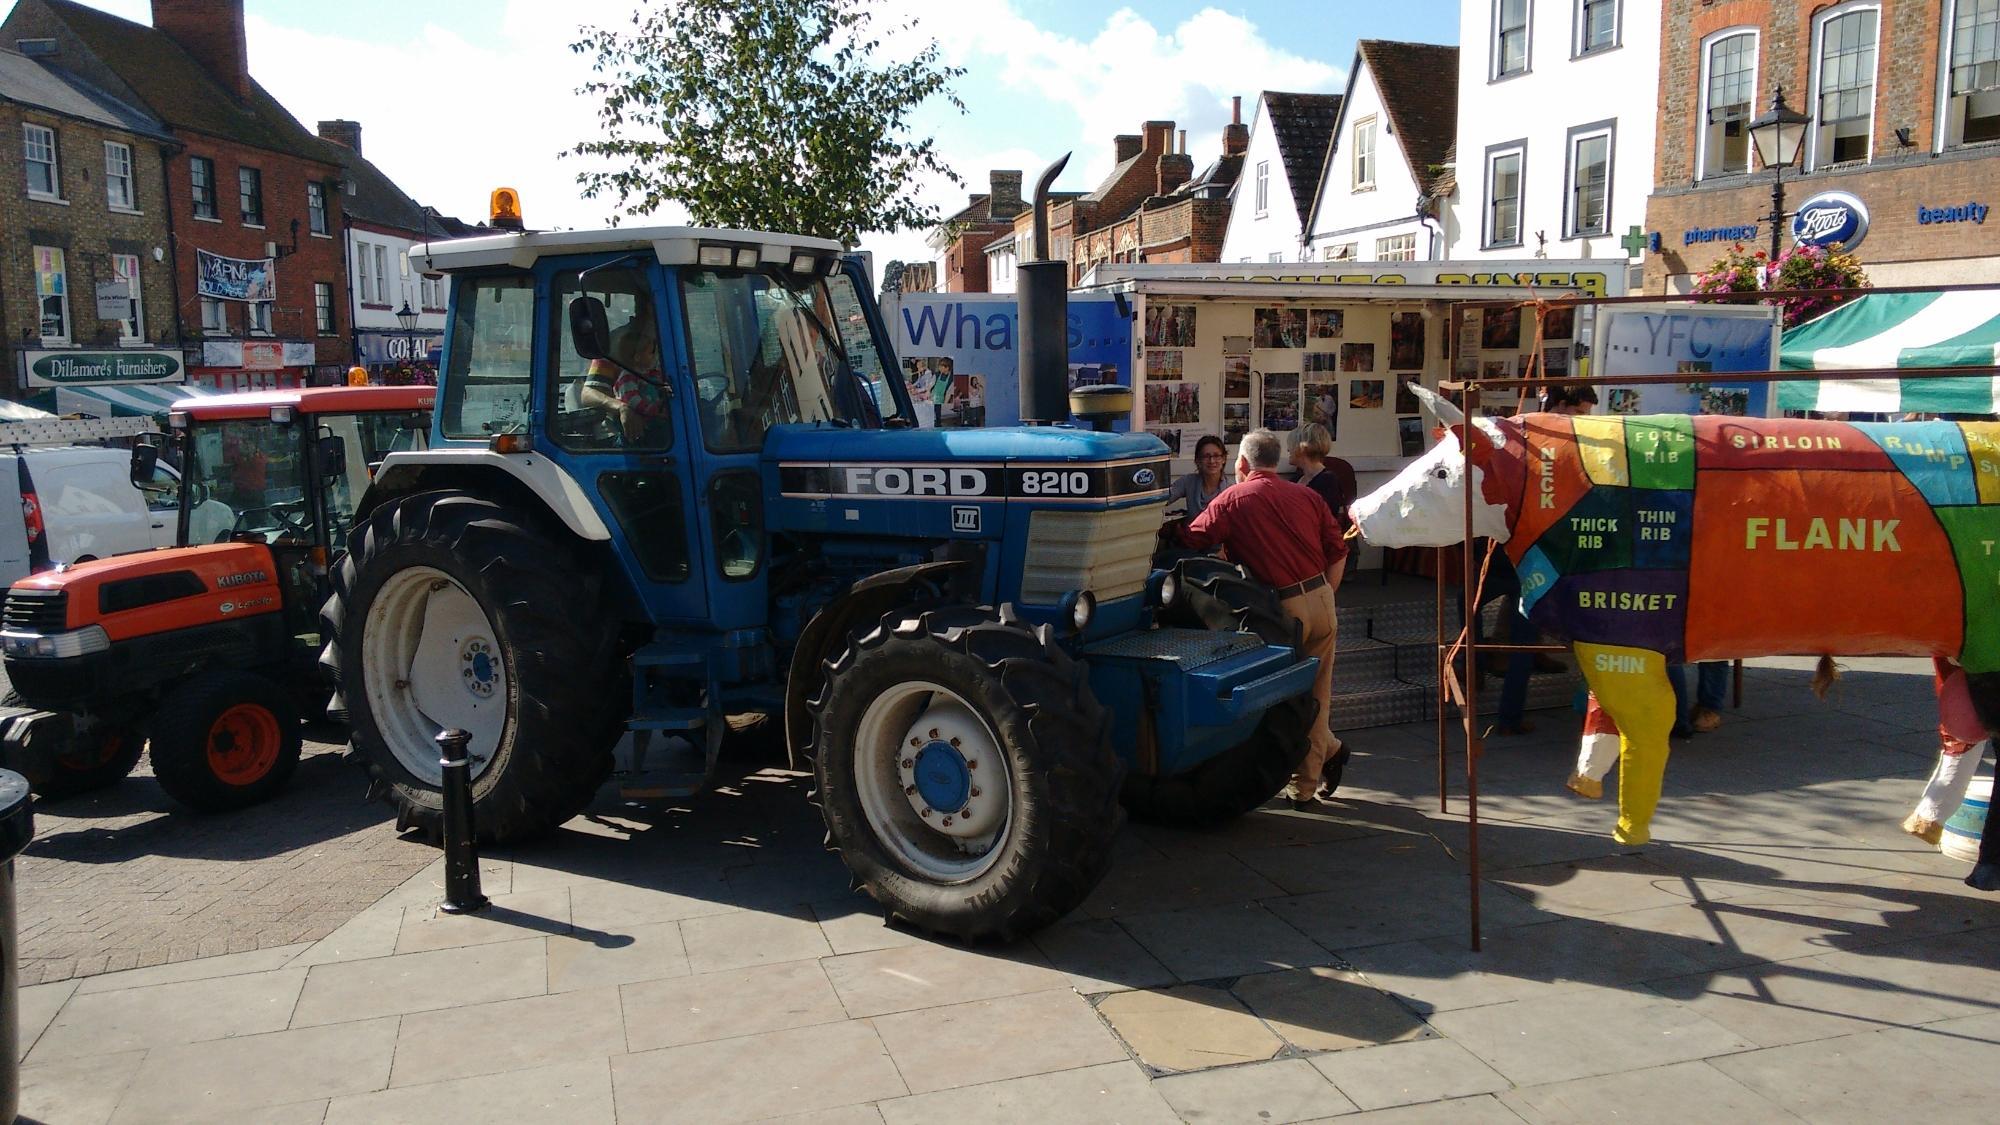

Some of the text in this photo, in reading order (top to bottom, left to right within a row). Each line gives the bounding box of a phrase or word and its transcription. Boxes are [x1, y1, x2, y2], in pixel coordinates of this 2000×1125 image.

[1801, 207, 1848, 239] Boots
[1917, 201, 1989, 225] beauty
[1683, 224, 1759, 247] pharmacy
[51, 358, 167, 378] Dillamore's Furnishers
[1635, 430, 1686, 442] FORE
[1732, 432, 1842, 450] SIRLOIN
[1644, 451, 1680, 464] RIB
[1884, 436, 1965, 470] RUMP
[845, 467, 987, 496] FORD
[1022, 471, 1090, 495] 8210
[1540, 446, 1557, 509] NECK
[1571, 517, 1618, 533] THICK
[1637, 510, 1677, 525] THIN
[1578, 534, 1603, 549] RIB
[1641, 527, 1671, 541] RIB
[1745, 517, 1902, 552] FLANK
[217, 571, 267, 588] KUBOTA
[1579, 591, 1677, 611] BRISKET
[1595, 653, 1645, 674] SHIN
